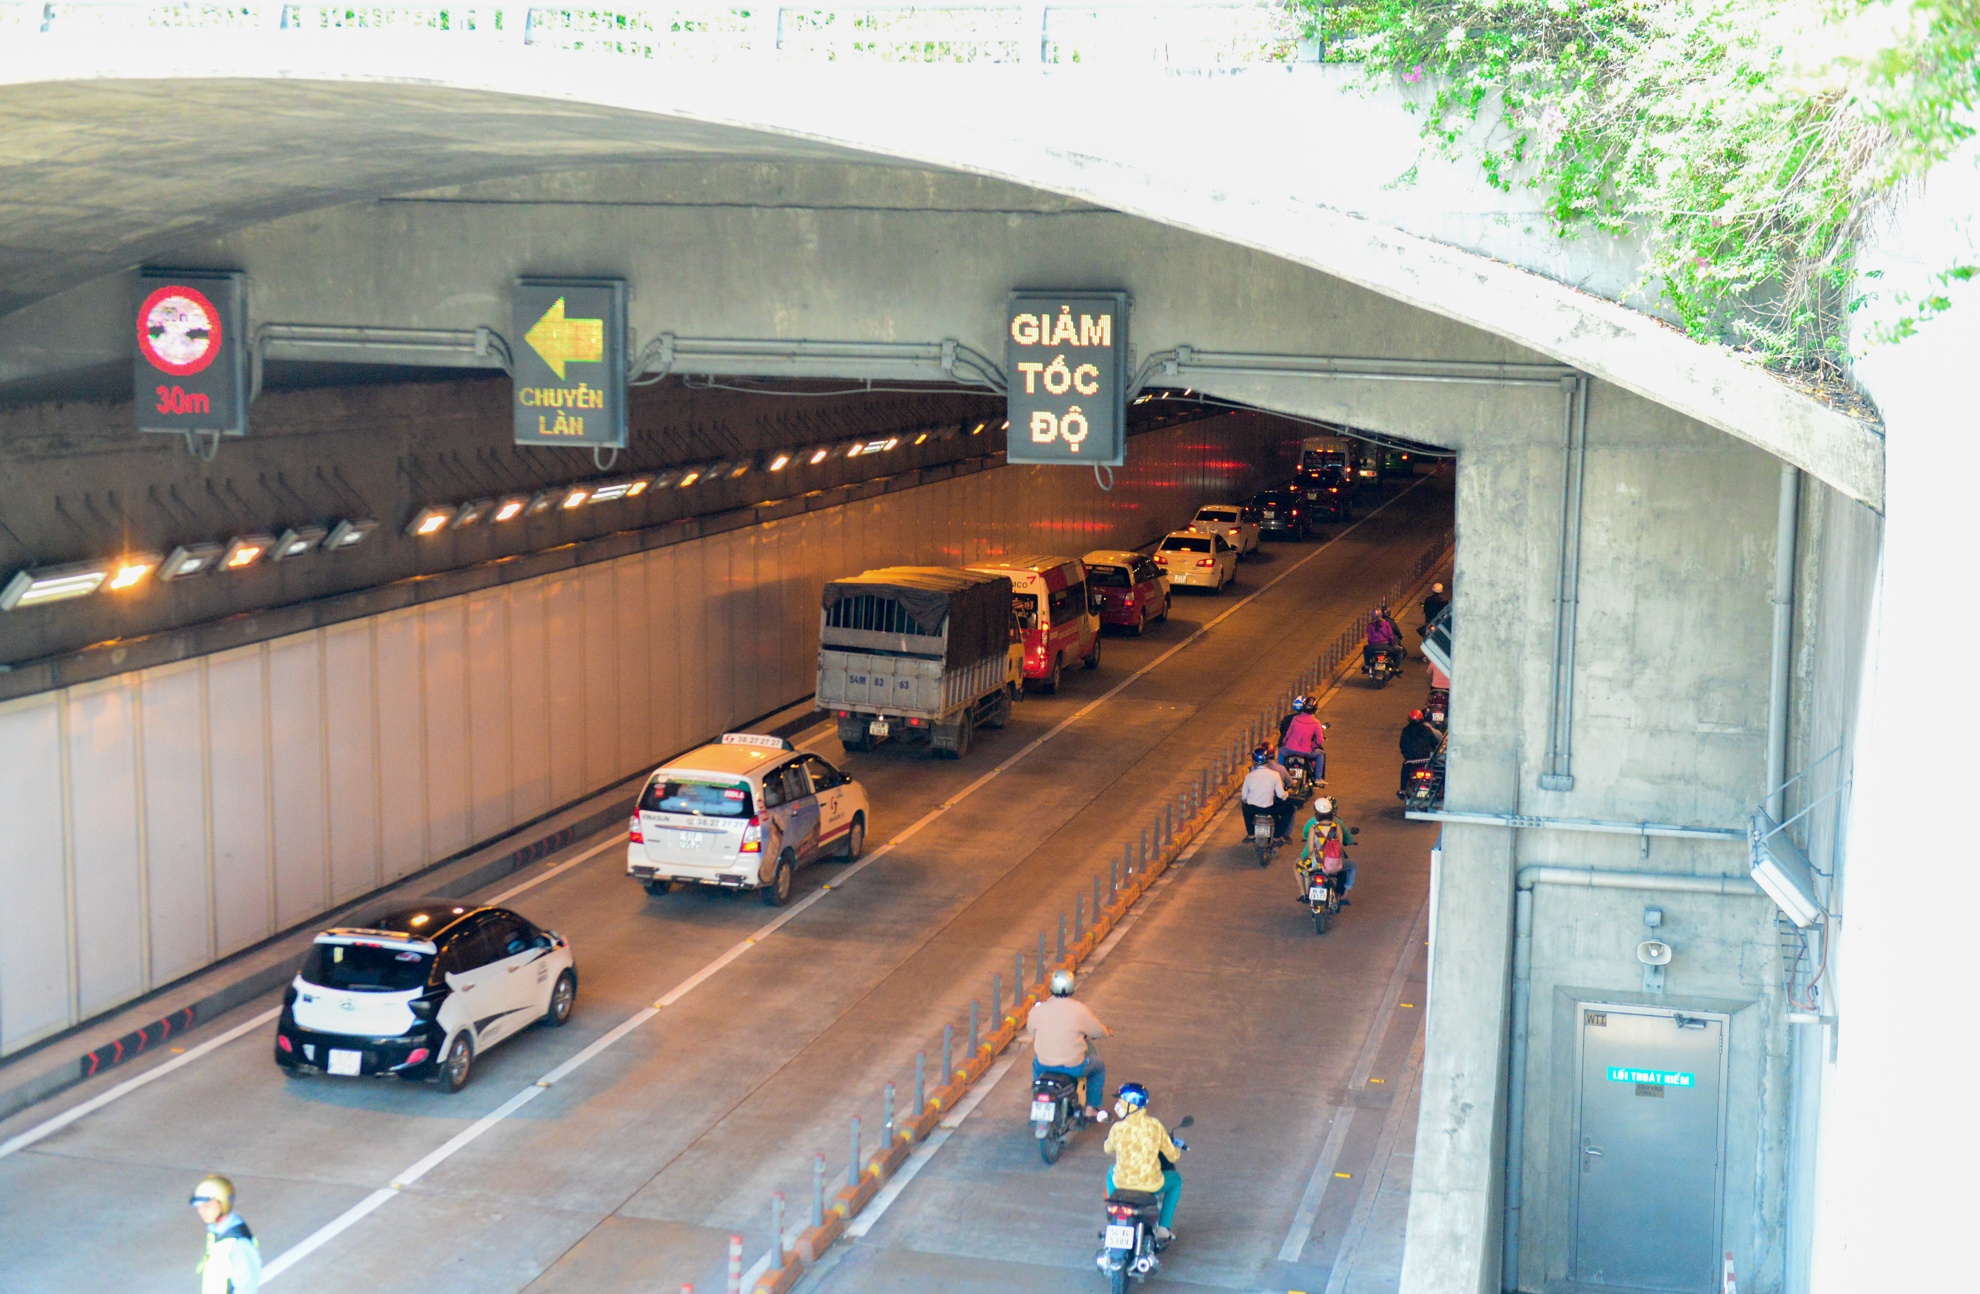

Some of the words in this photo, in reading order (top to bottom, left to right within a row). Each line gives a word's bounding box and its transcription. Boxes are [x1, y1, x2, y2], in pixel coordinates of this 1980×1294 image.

[1011, 305, 1111, 346] GIẢM
[1018, 354, 1099, 395] TỐC
[155, 384, 210, 415] 30m
[538, 409, 584, 436] LÀN
[1030, 405, 1088, 453] ĐỘ
[849, 675, 866, 685] 54M
[899, 680, 909, 690] 63
